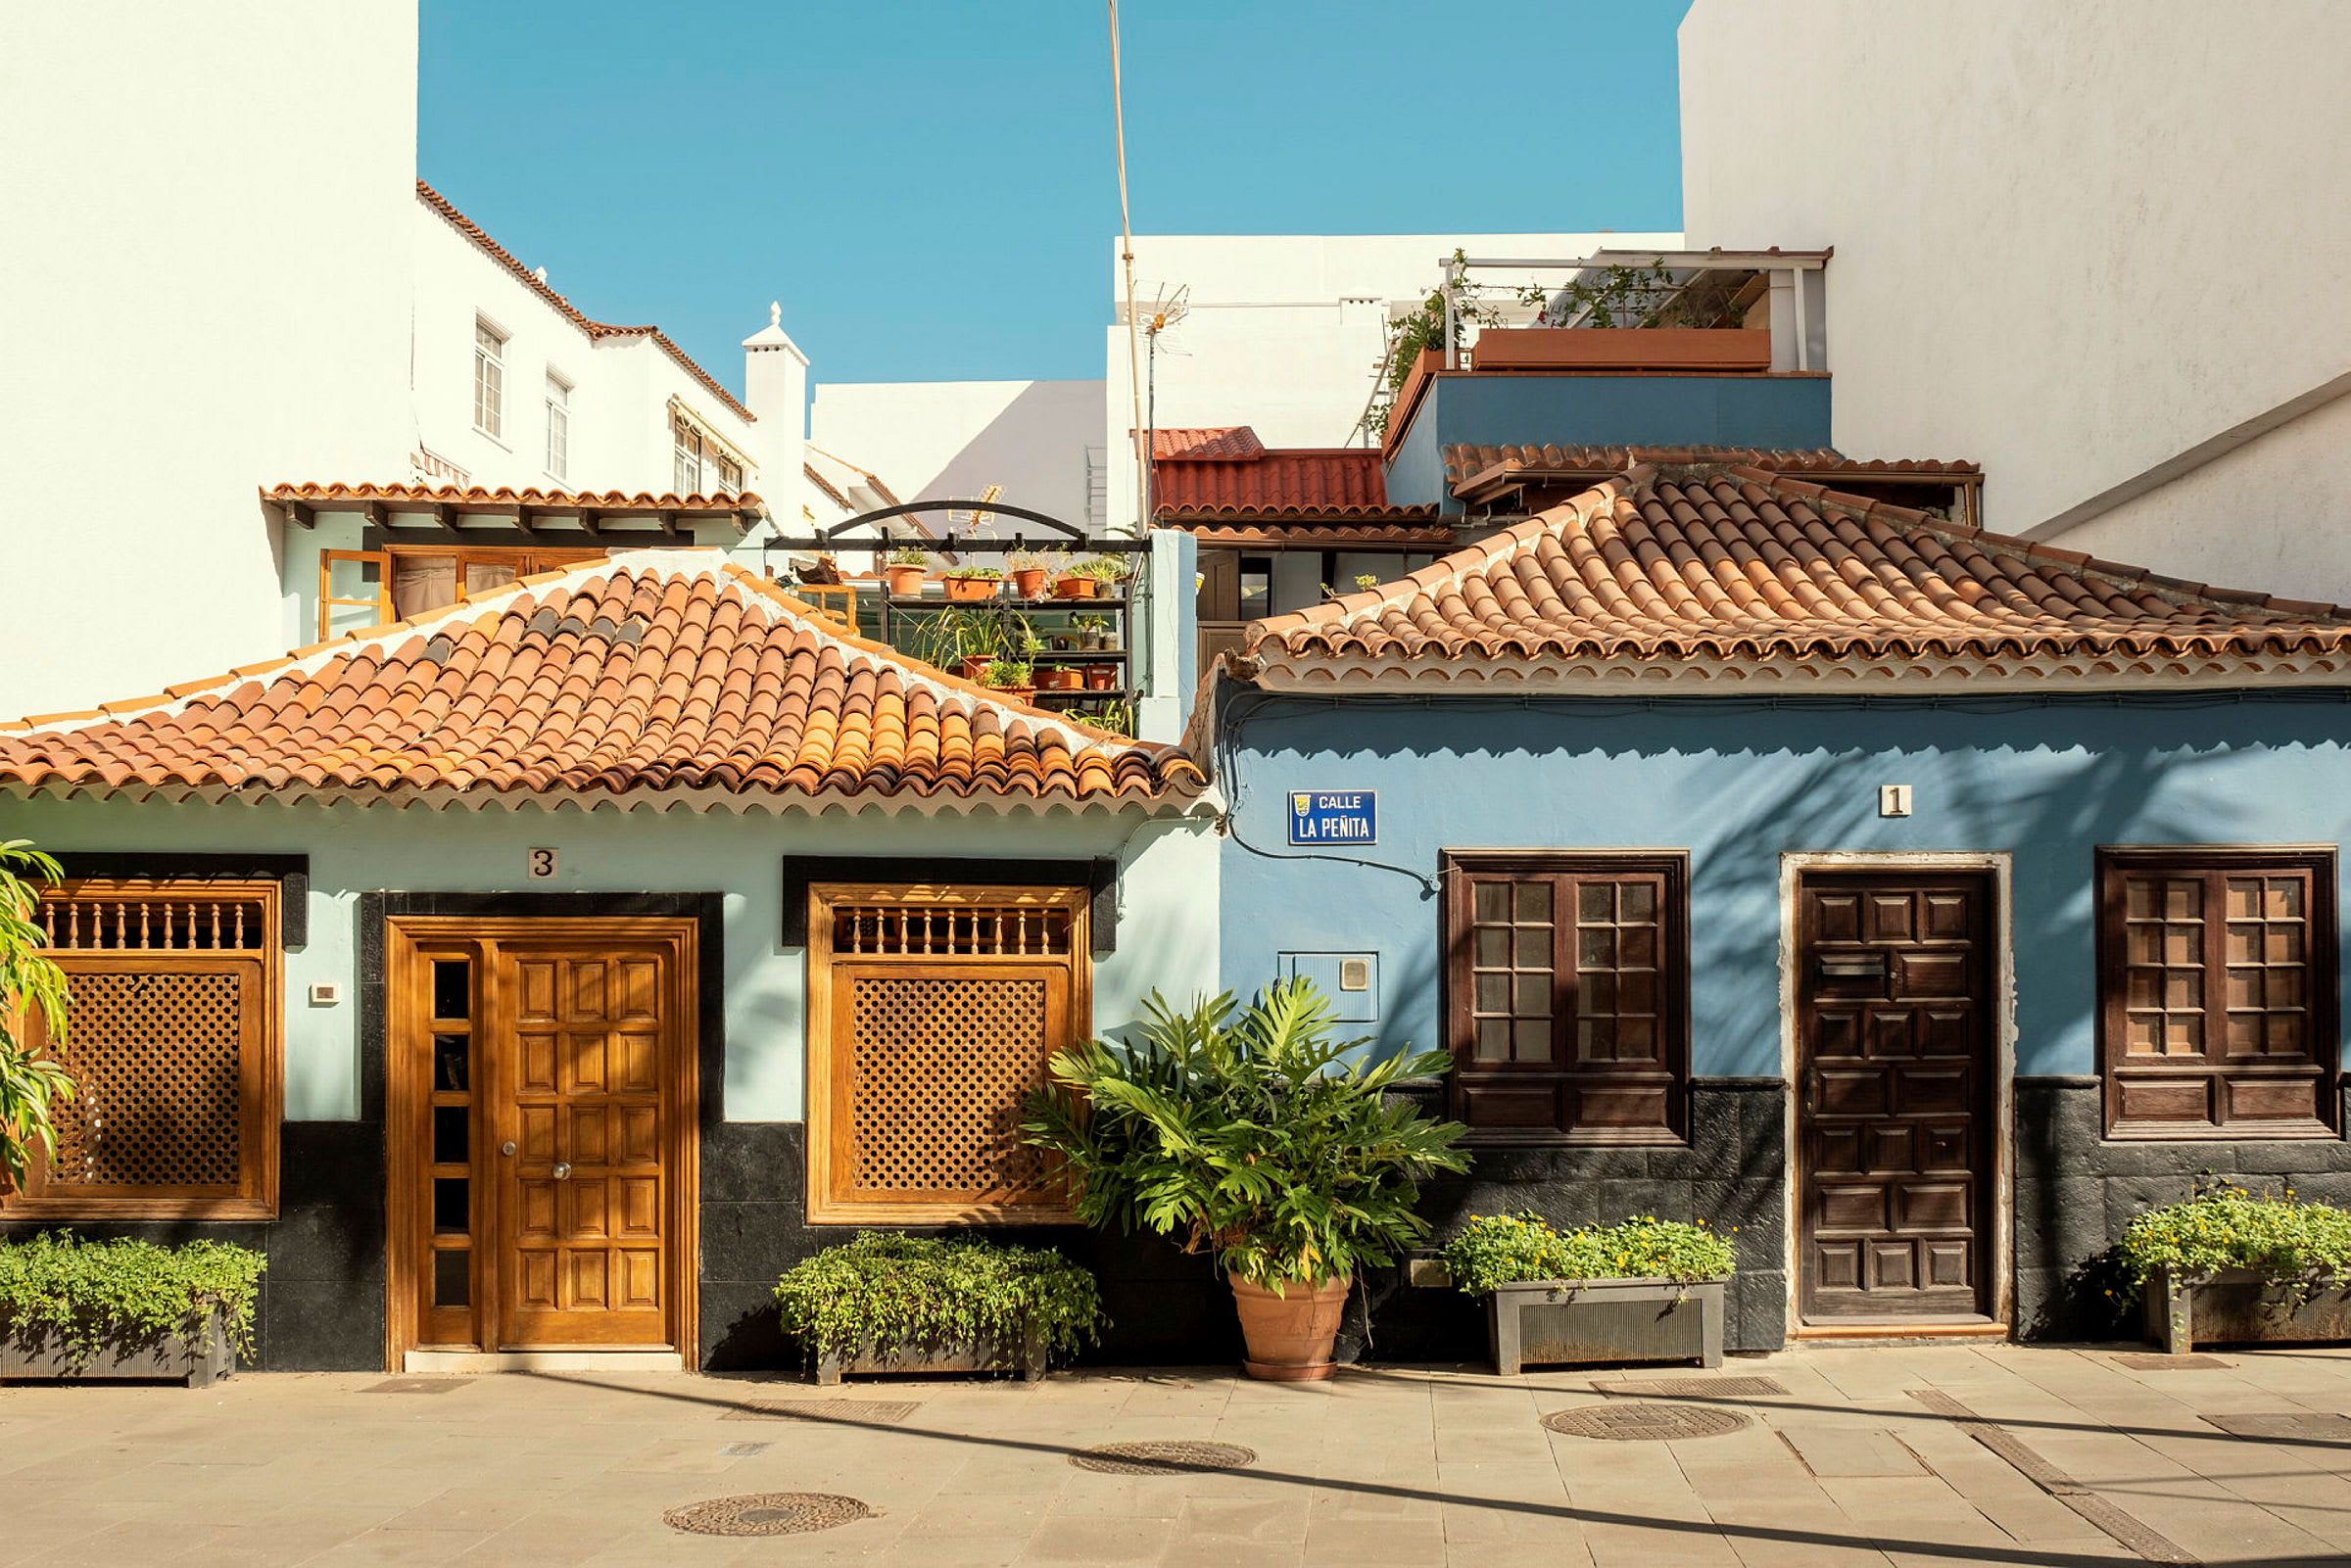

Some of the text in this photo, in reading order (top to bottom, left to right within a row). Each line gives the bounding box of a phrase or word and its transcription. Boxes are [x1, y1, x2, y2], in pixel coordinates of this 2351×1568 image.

[1319, 796, 1362, 809] CALLE
[1889, 787, 1903, 815] 1
[1299, 815, 1369, 837] LA PEÑITA
[534, 849, 552, 877] 3
